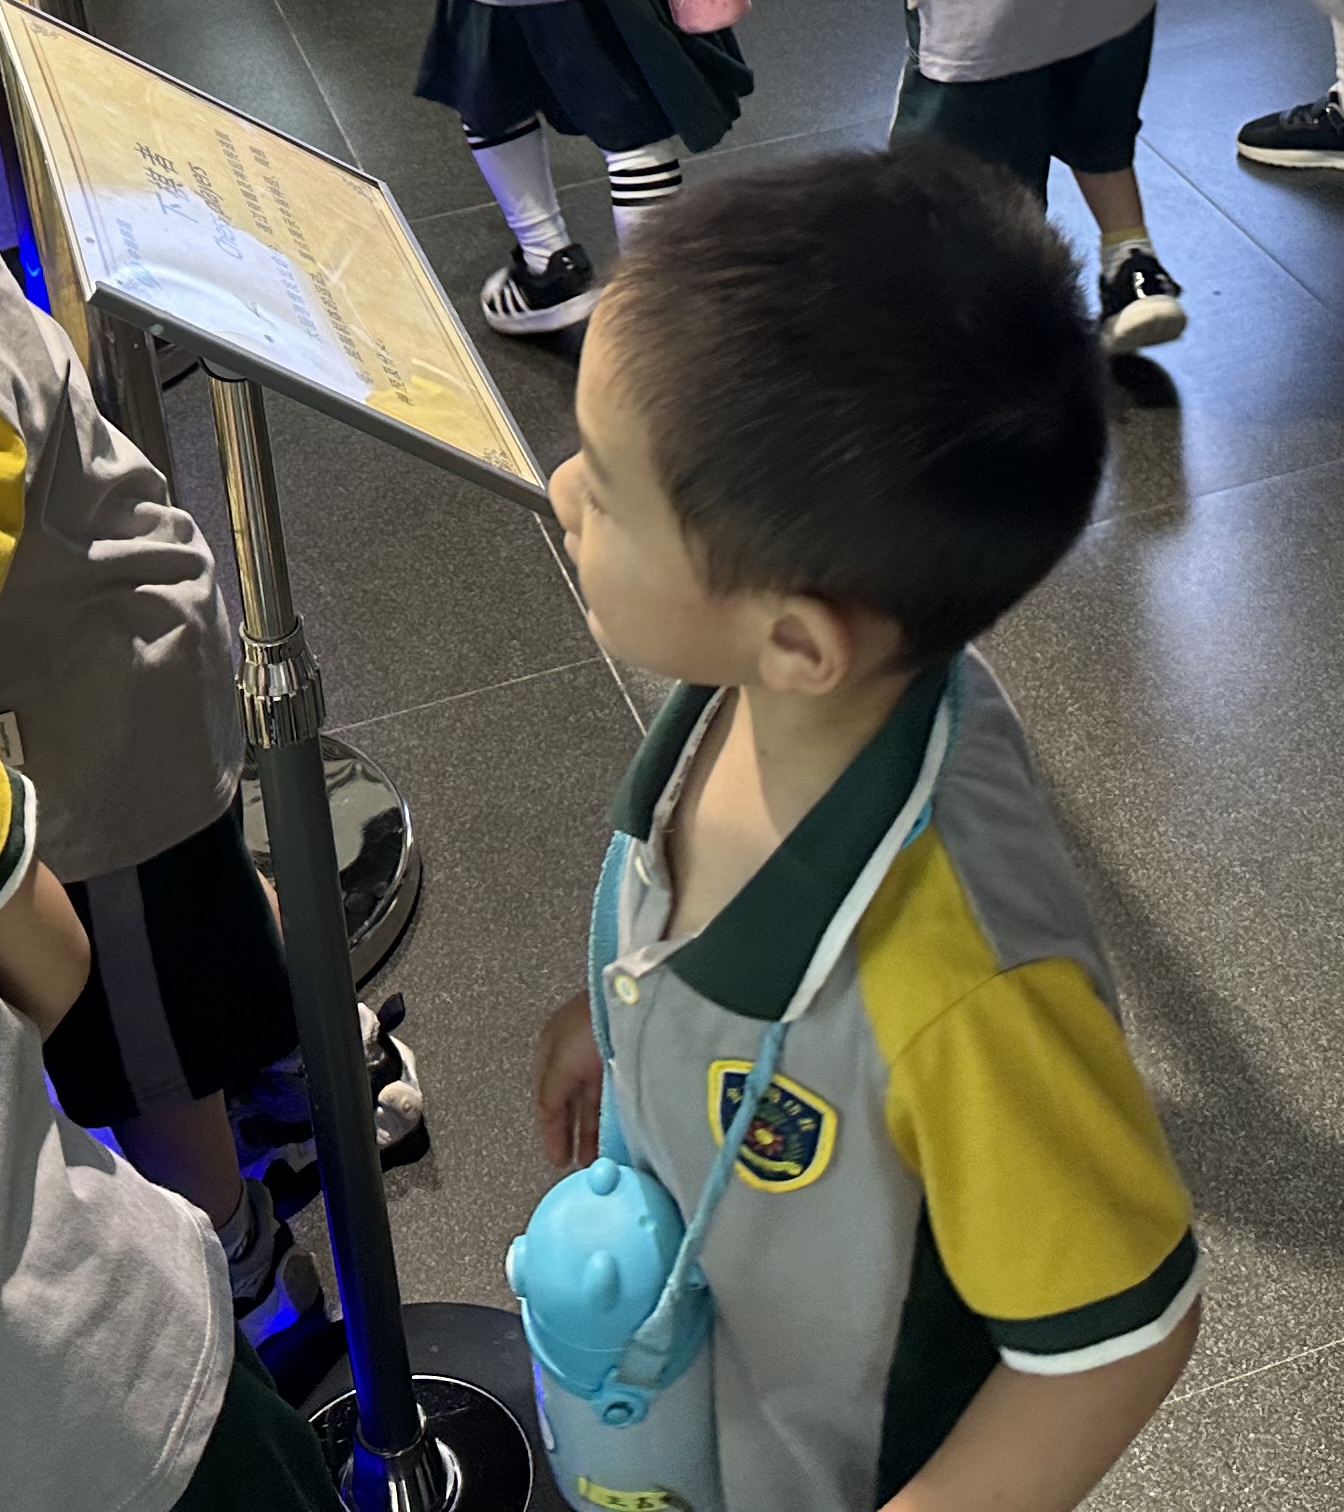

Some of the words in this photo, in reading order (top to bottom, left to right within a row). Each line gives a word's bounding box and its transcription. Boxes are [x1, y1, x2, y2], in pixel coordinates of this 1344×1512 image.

[134, 141, 199, 224] 下棋者
[187, 161, 232, 221] players
[210, 213, 243, 260] Chess
